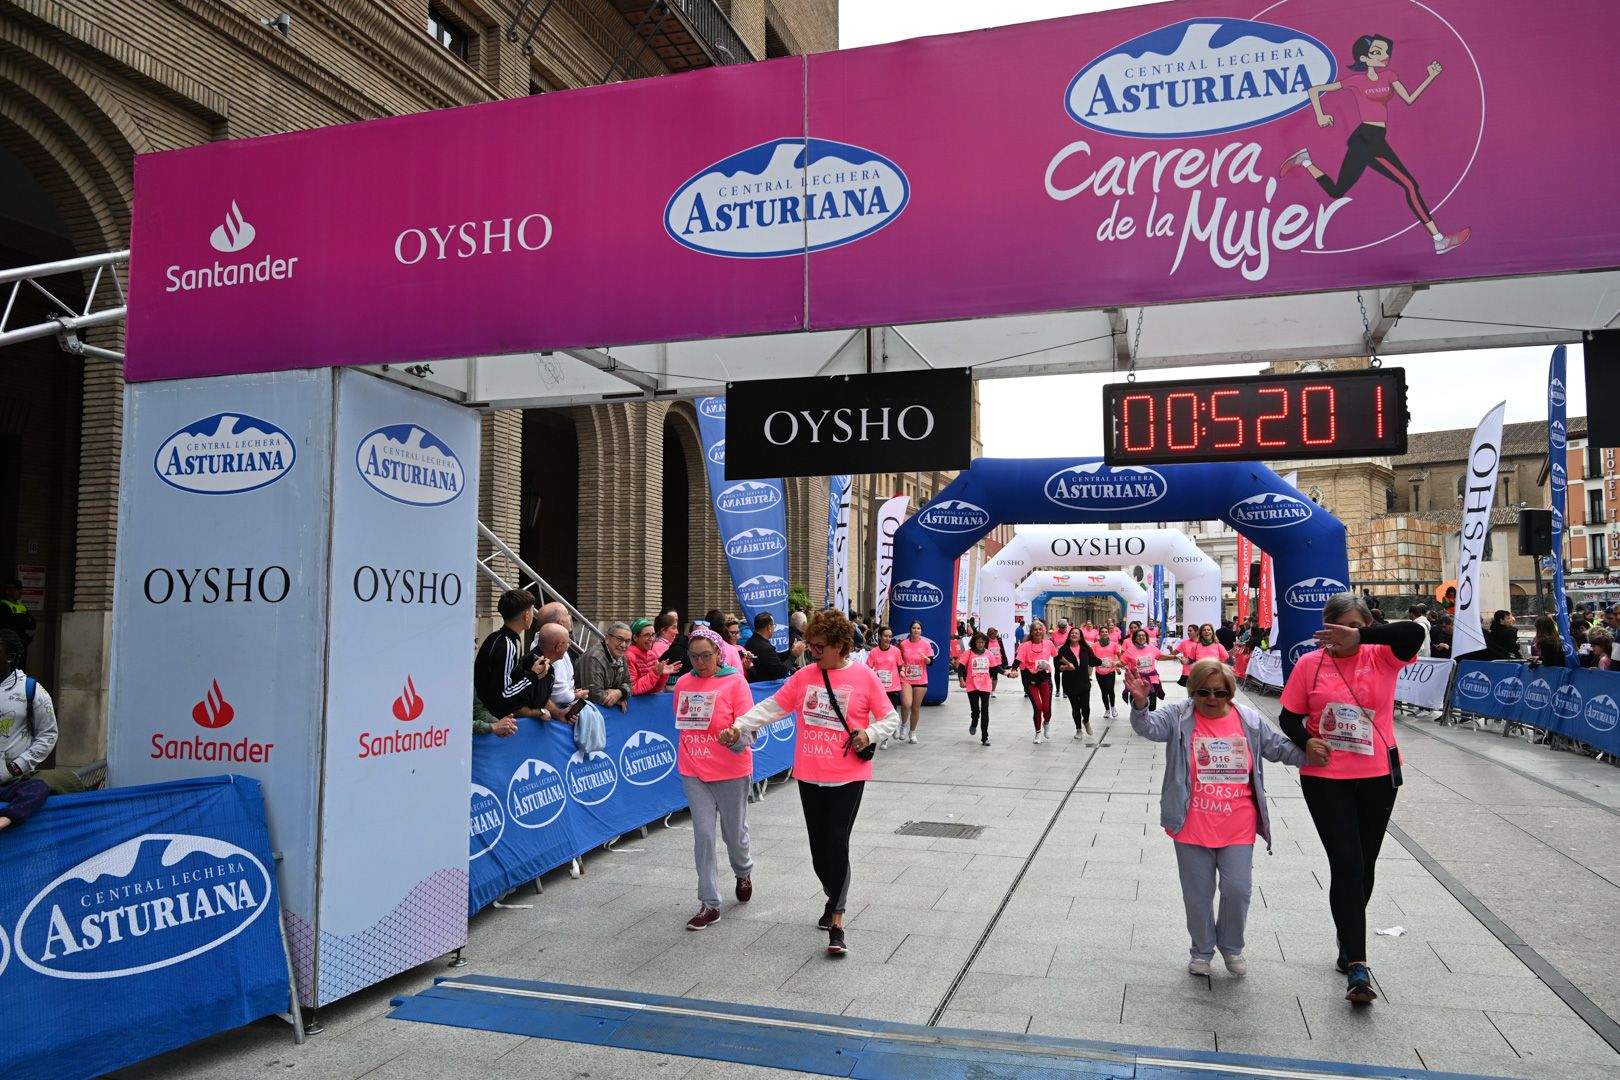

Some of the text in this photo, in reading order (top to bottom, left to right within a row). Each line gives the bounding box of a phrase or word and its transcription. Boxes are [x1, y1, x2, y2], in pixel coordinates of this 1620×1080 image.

[1124, 47, 1305, 79] CENTRAL LECHERA
[1085, 63, 1312, 117] ASTURIANA
[718, 168, 881, 198] CENTRAL LECHERA
[1044, 140, 1263, 201] Carrera
[681, 185, 890, 235] ASTURIANA
[394, 213, 553, 265] OYSHO
[1096, 176, 1353, 281] de la Mujer
[165, 254, 299, 292] Santander
[763, 404, 935, 446] OYSHO
[187, 439, 281, 452] CENTRAL LECHERA
[383, 446, 455, 468] CENTRAL LECHERA
[164, 446, 285, 476] ASTURIANA
[364, 444, 458, 492] ASTURIANA
[1053, 478, 1158, 498] ASTURIANA
[921, 512, 984, 525] ASTURIANA
[1236, 507, 1308, 520] ASTURIANA
[1460, 443, 1498, 611] OYSHO
[1051, 536, 1146, 557] OYSHO
[1172, 555, 1203, 564] OYSHO
[996, 559, 1025, 567] OYSHO
[143, 565, 291, 604] OYSHO
[353, 565, 462, 606] OYSHO
[1399, 663, 1434, 683] SHO
[1338, 722, 1357, 731] 016
[150, 733, 274, 763] Santander
[358, 725, 450, 759] Santander
[802, 743, 833, 755] SUMA
[625, 750, 674, 777] ASTURIANA
[1211, 755, 1230, 763] 016
[570, 769, 615, 795] ASTURIANA
[513, 783, 565, 819] ASTURIANA
[1192, 796, 1232, 813] SUMA
[80, 863, 246, 908] CENTRAL LECHERA
[41, 877, 258, 962] ASTURIANA
